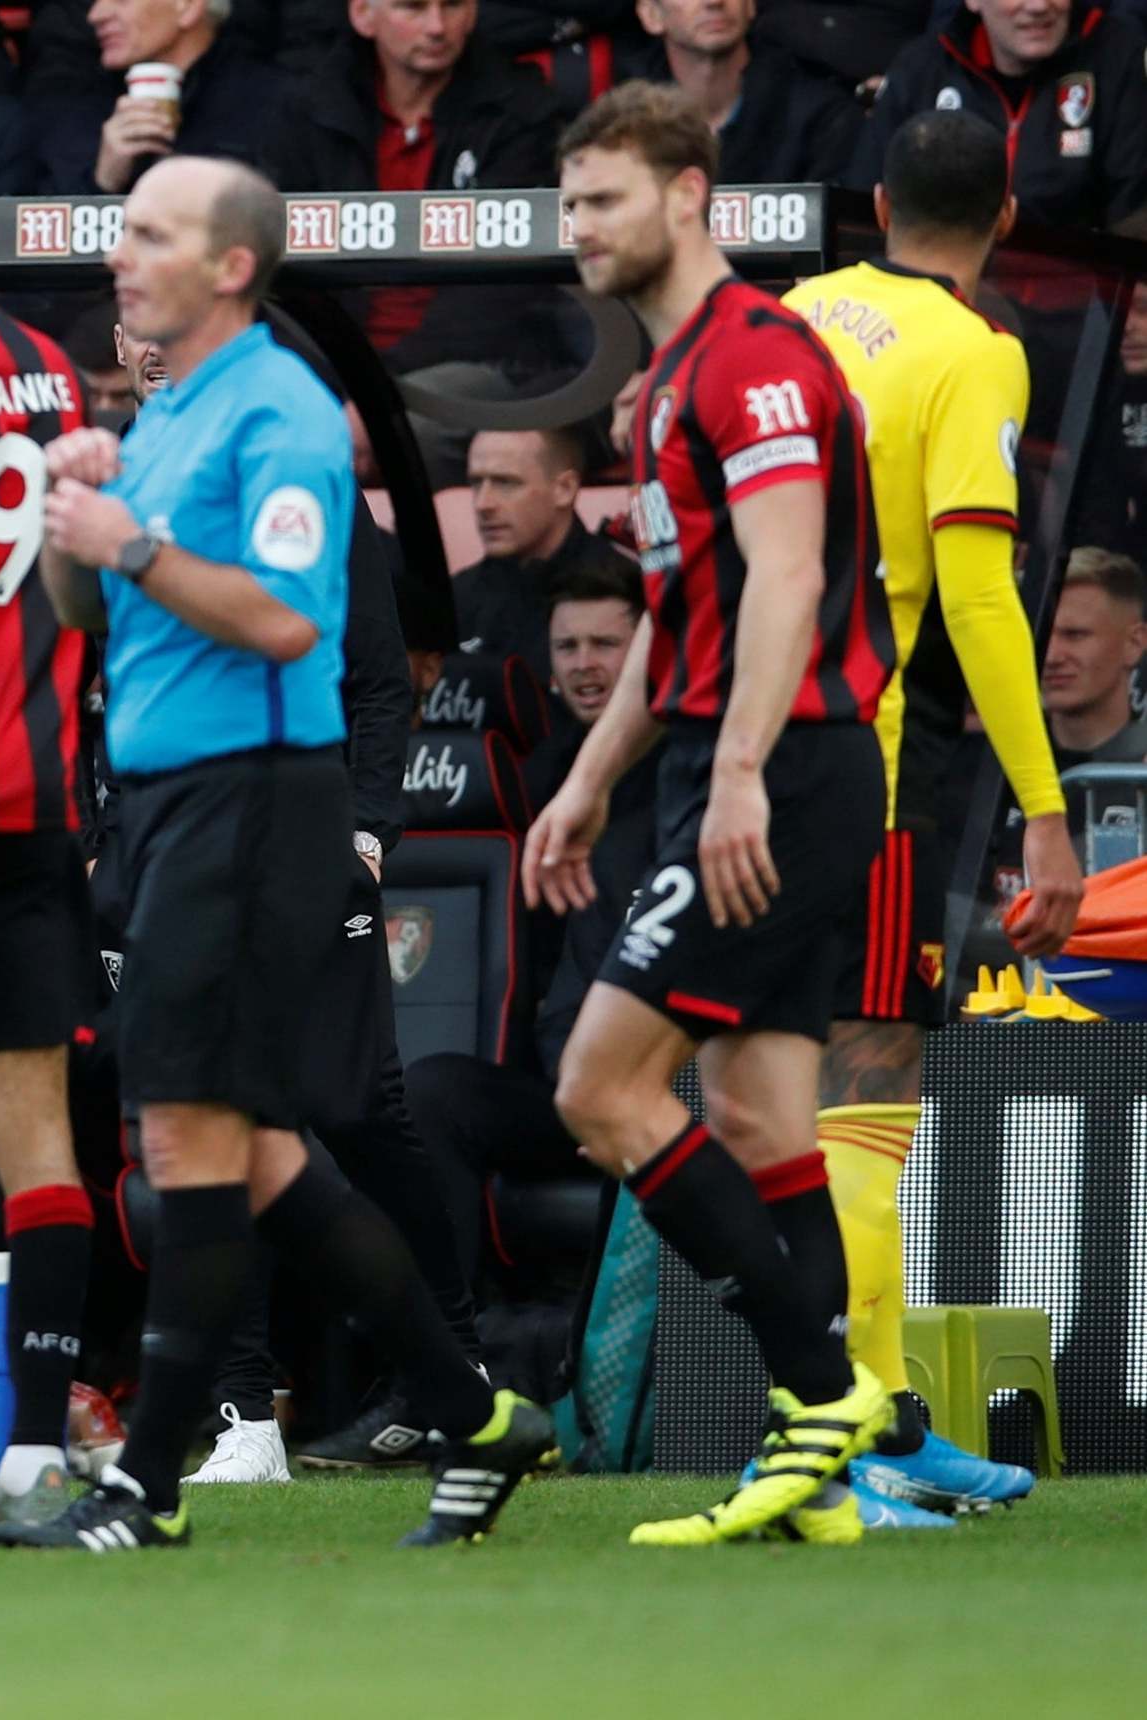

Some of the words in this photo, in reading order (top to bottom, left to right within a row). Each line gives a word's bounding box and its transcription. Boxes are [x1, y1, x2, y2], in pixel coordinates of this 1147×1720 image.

[289, 201, 396, 250] M88
[423, 199, 531, 248] M88
[806, 297, 896, 358] APOUE
[630, 864, 696, 947] 2
